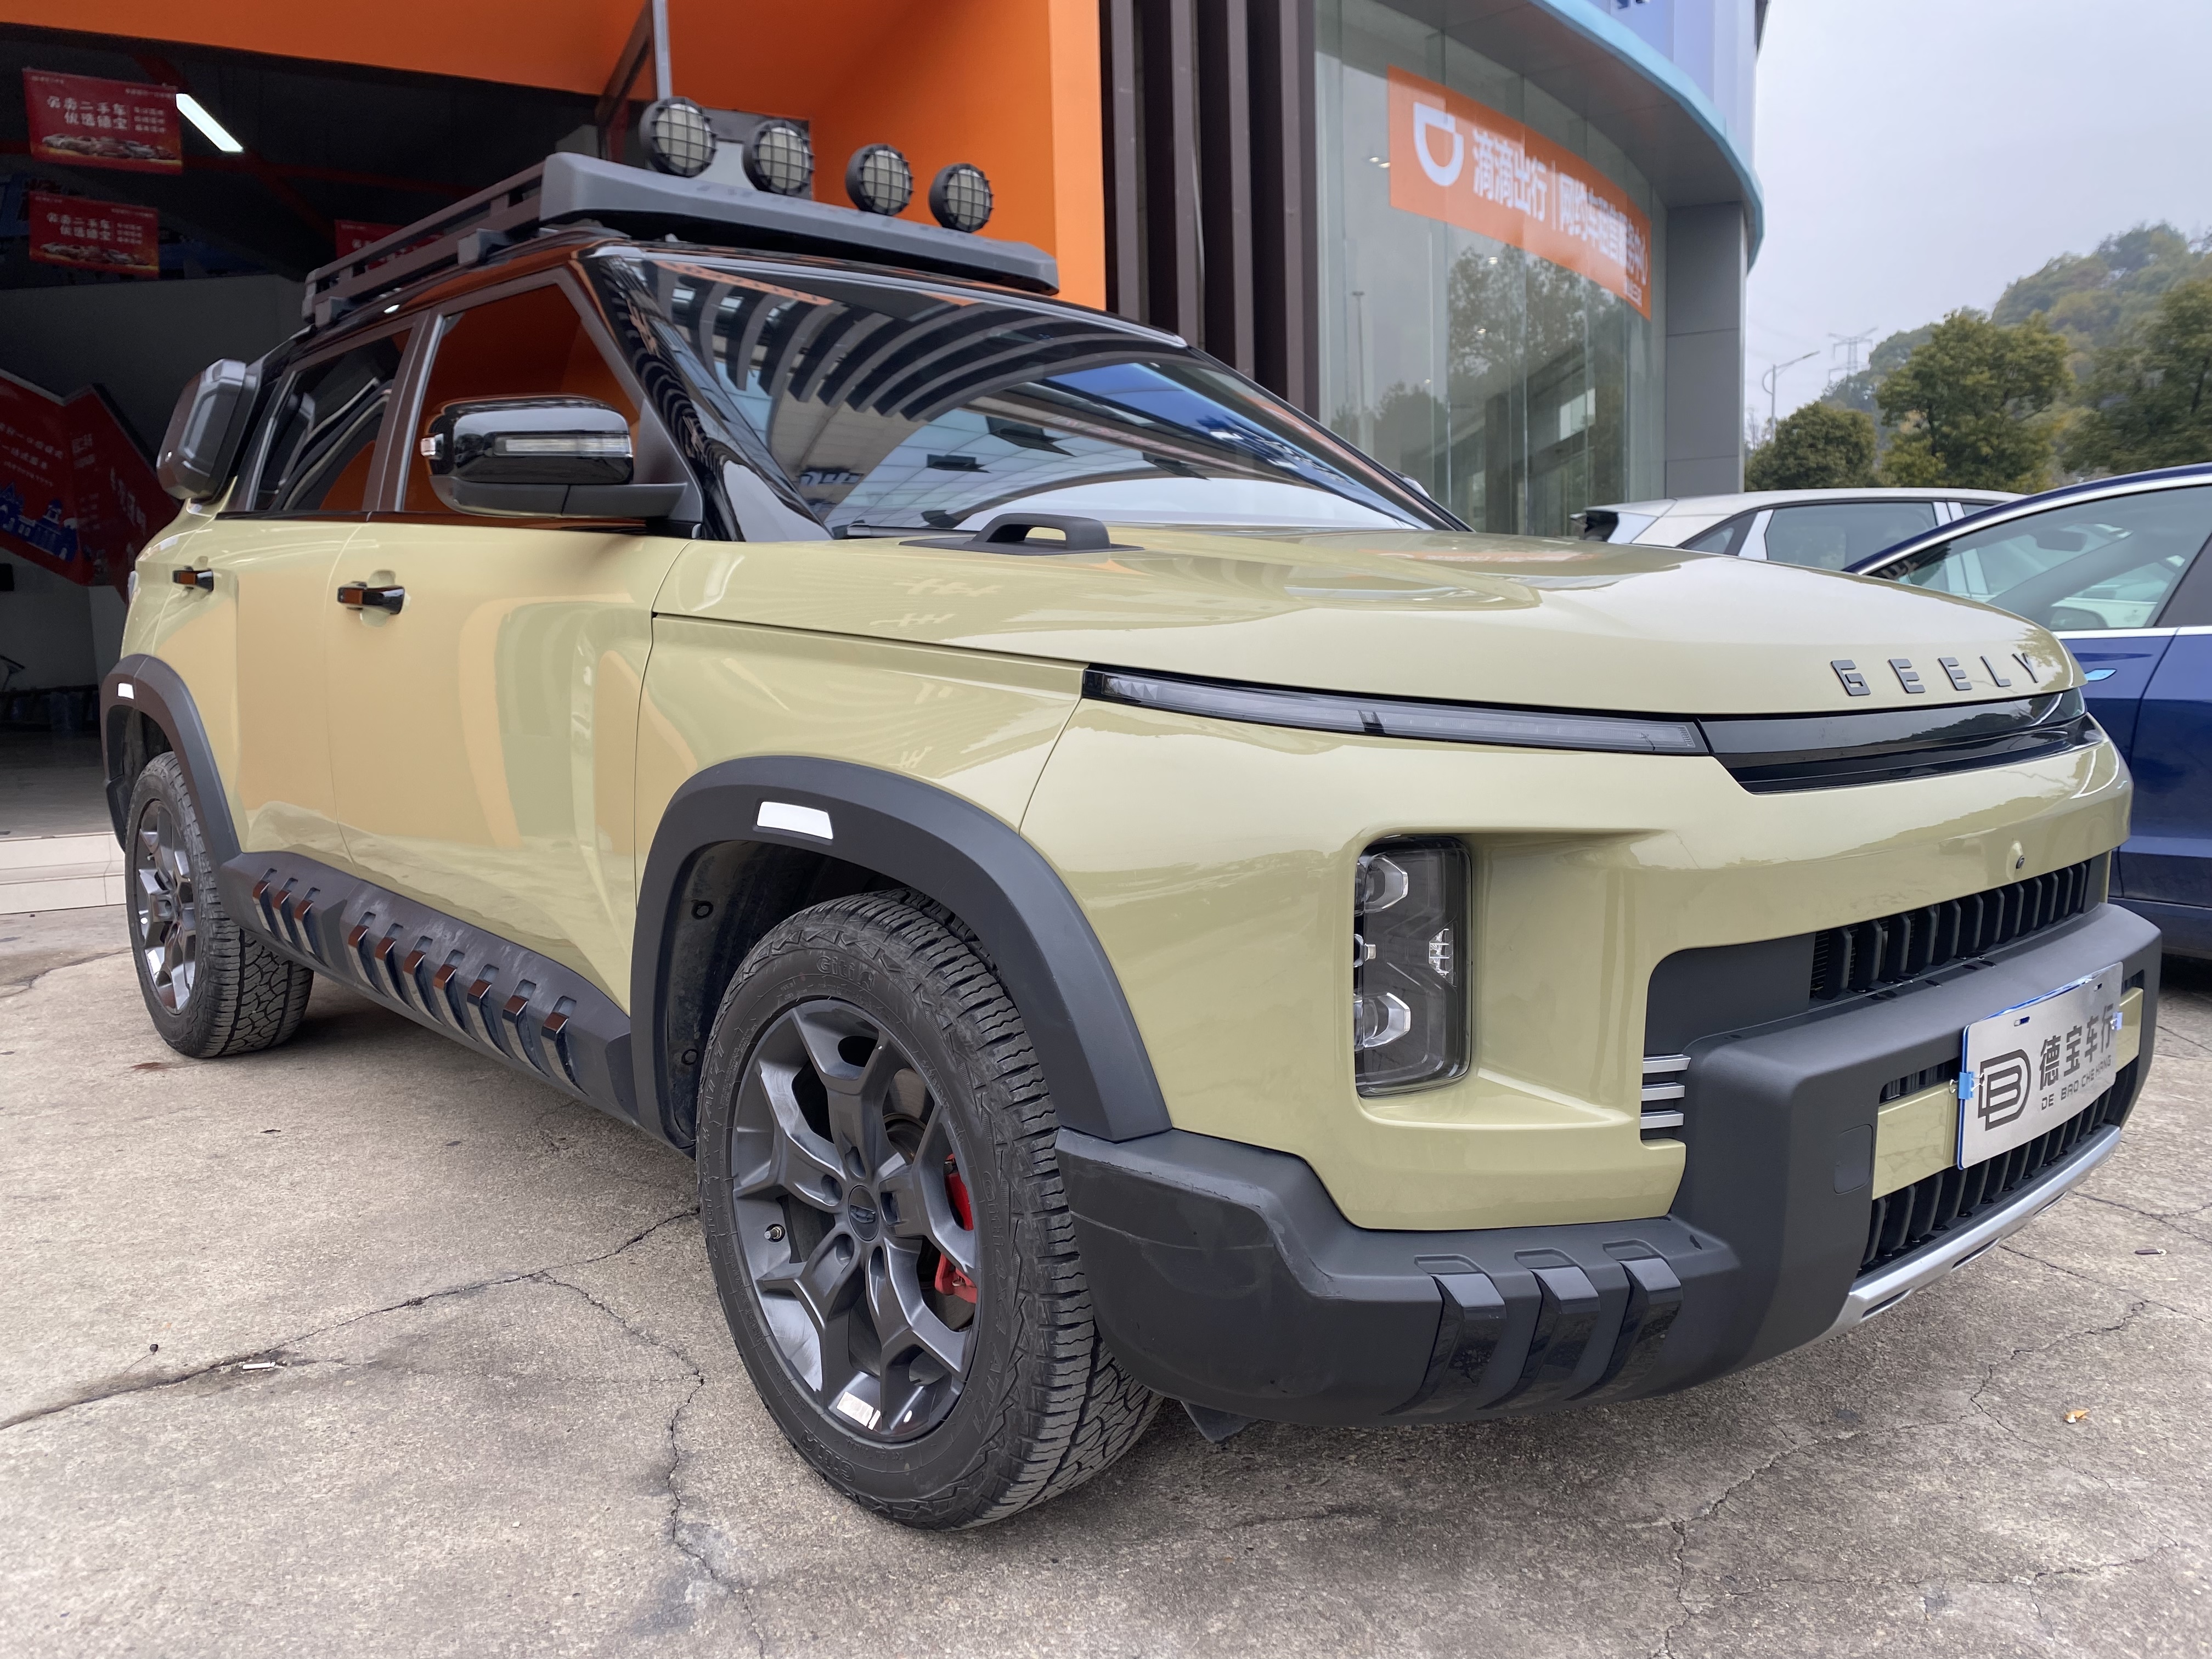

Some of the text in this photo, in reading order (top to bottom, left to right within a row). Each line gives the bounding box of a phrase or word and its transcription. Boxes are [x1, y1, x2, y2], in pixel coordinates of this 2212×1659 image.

[1472, 128, 1547, 222] 滴滴出行
[1830, 653, 2039, 696] GEELY
[2039, 1003, 2114, 1091] 德宝车行
[2041, 1093, 2055, 1111] DE
[2061, 1080, 2079, 1101] BAO
